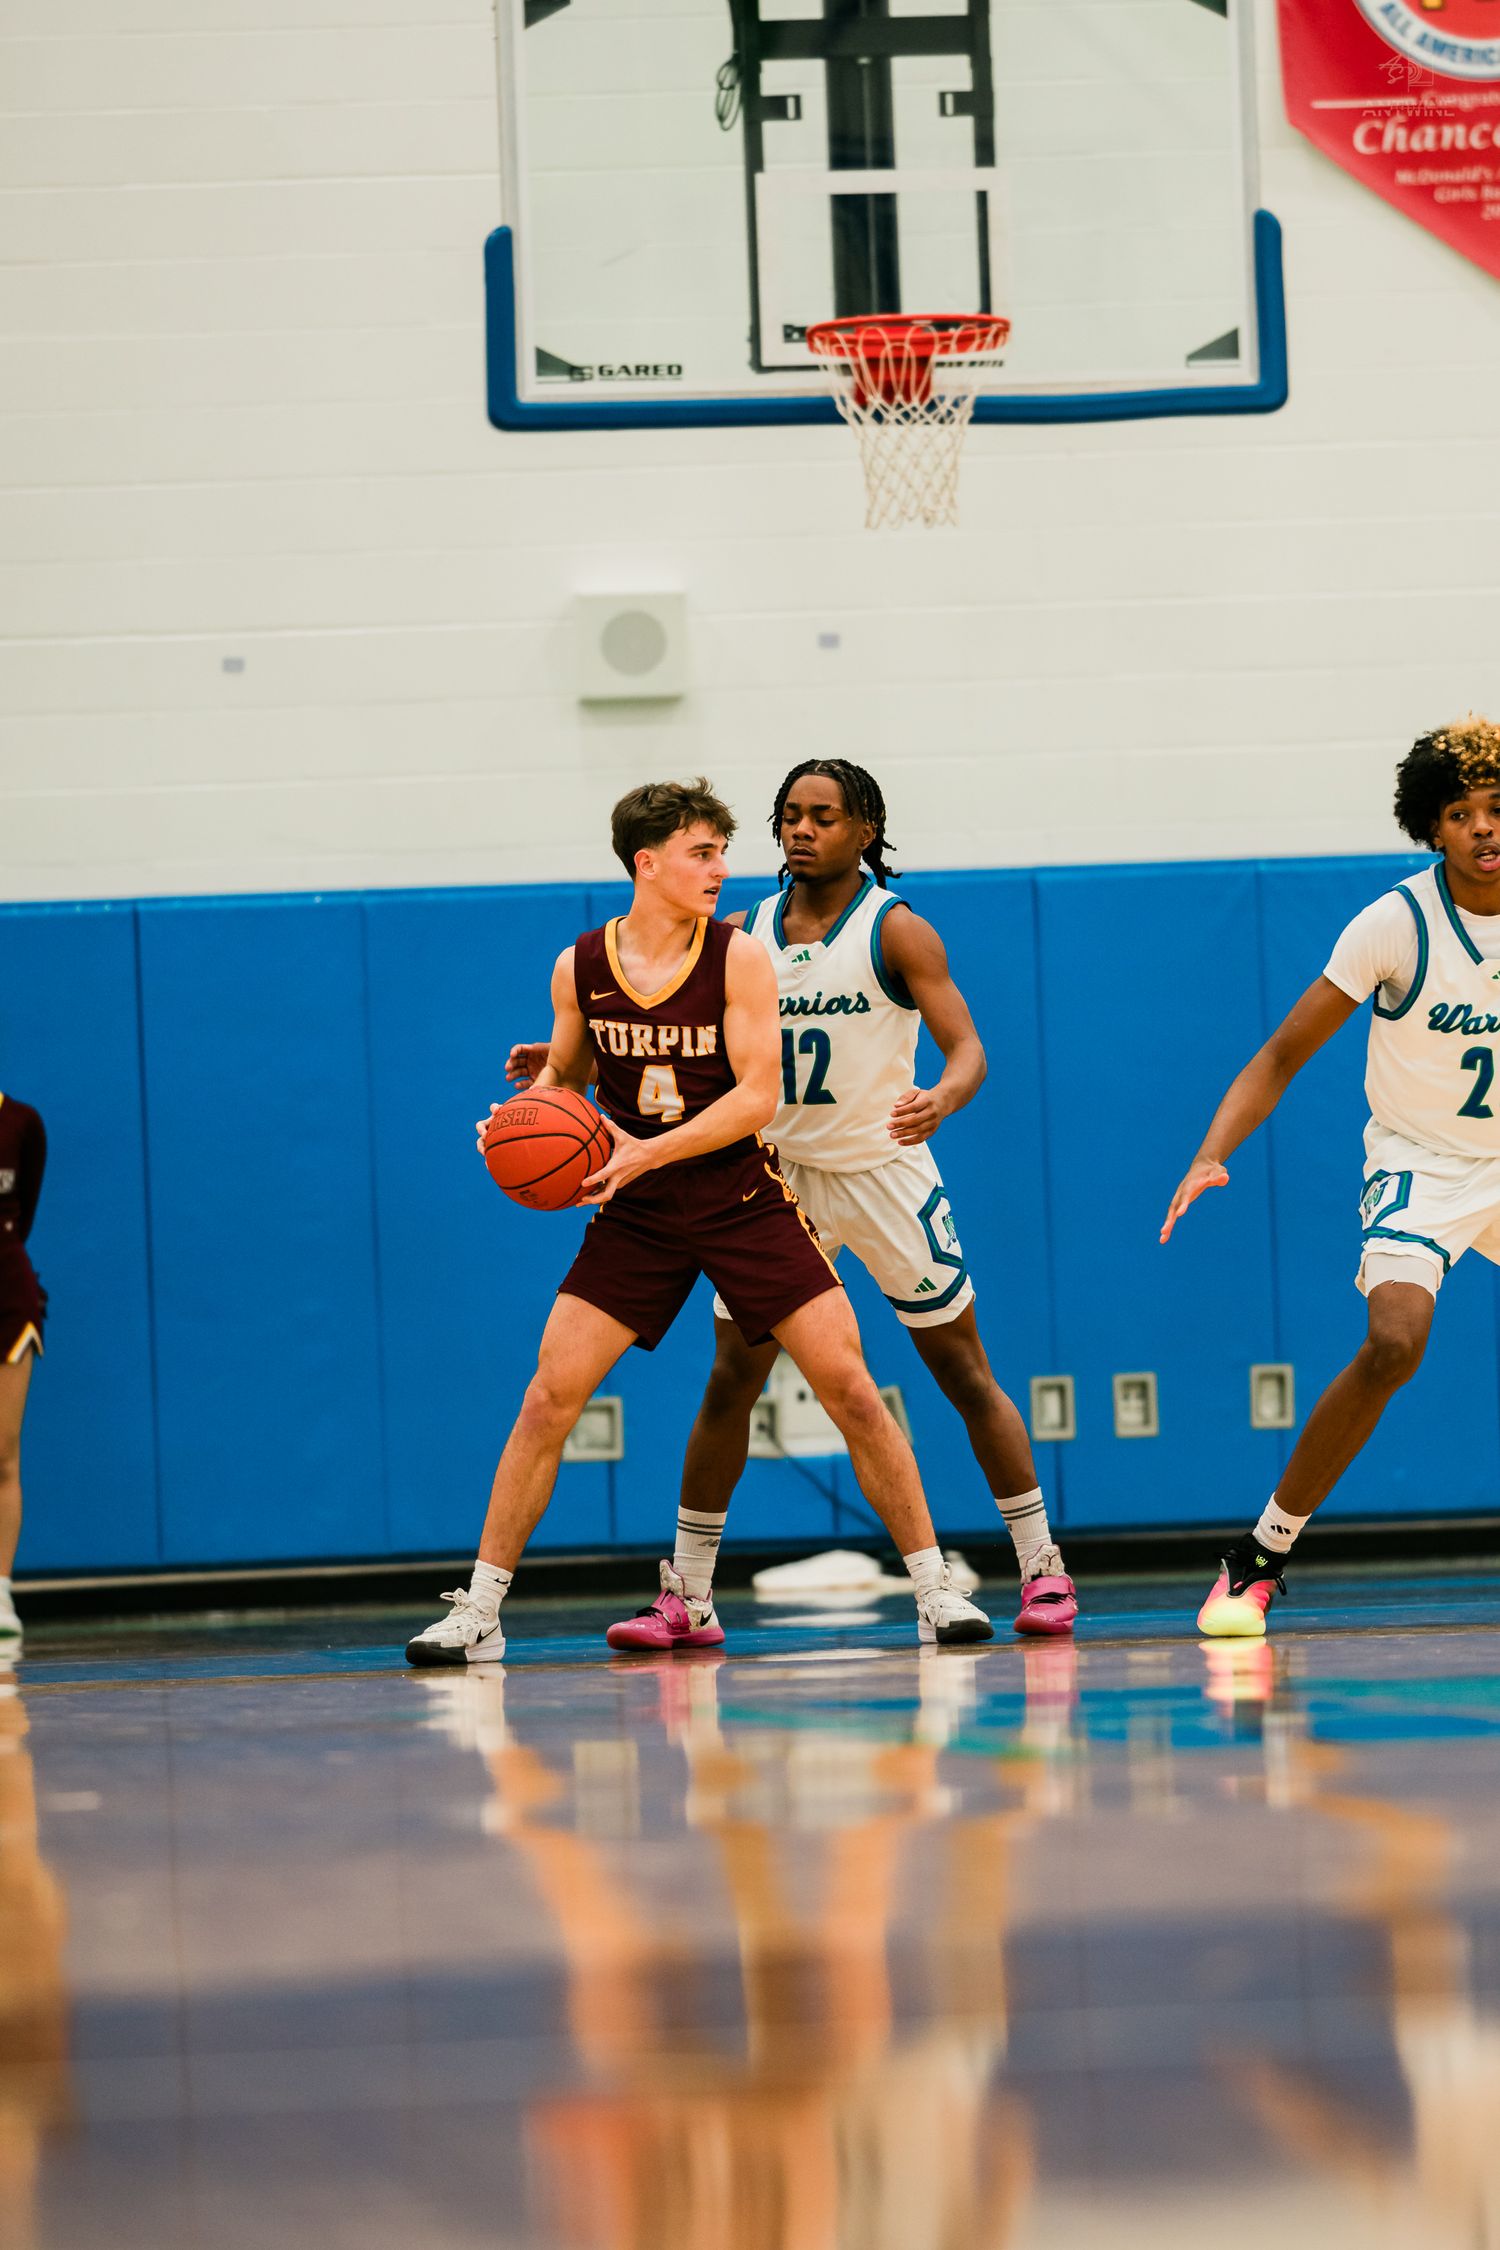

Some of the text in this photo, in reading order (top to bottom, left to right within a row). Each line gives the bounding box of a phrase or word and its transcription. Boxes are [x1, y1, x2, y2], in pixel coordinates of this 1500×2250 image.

[598, 364, 683, 376] GARED
[589, 1019, 717, 1057] TURPIN
[781, 1028, 837, 1104] 12
[637, 1064, 685, 1123] 4
